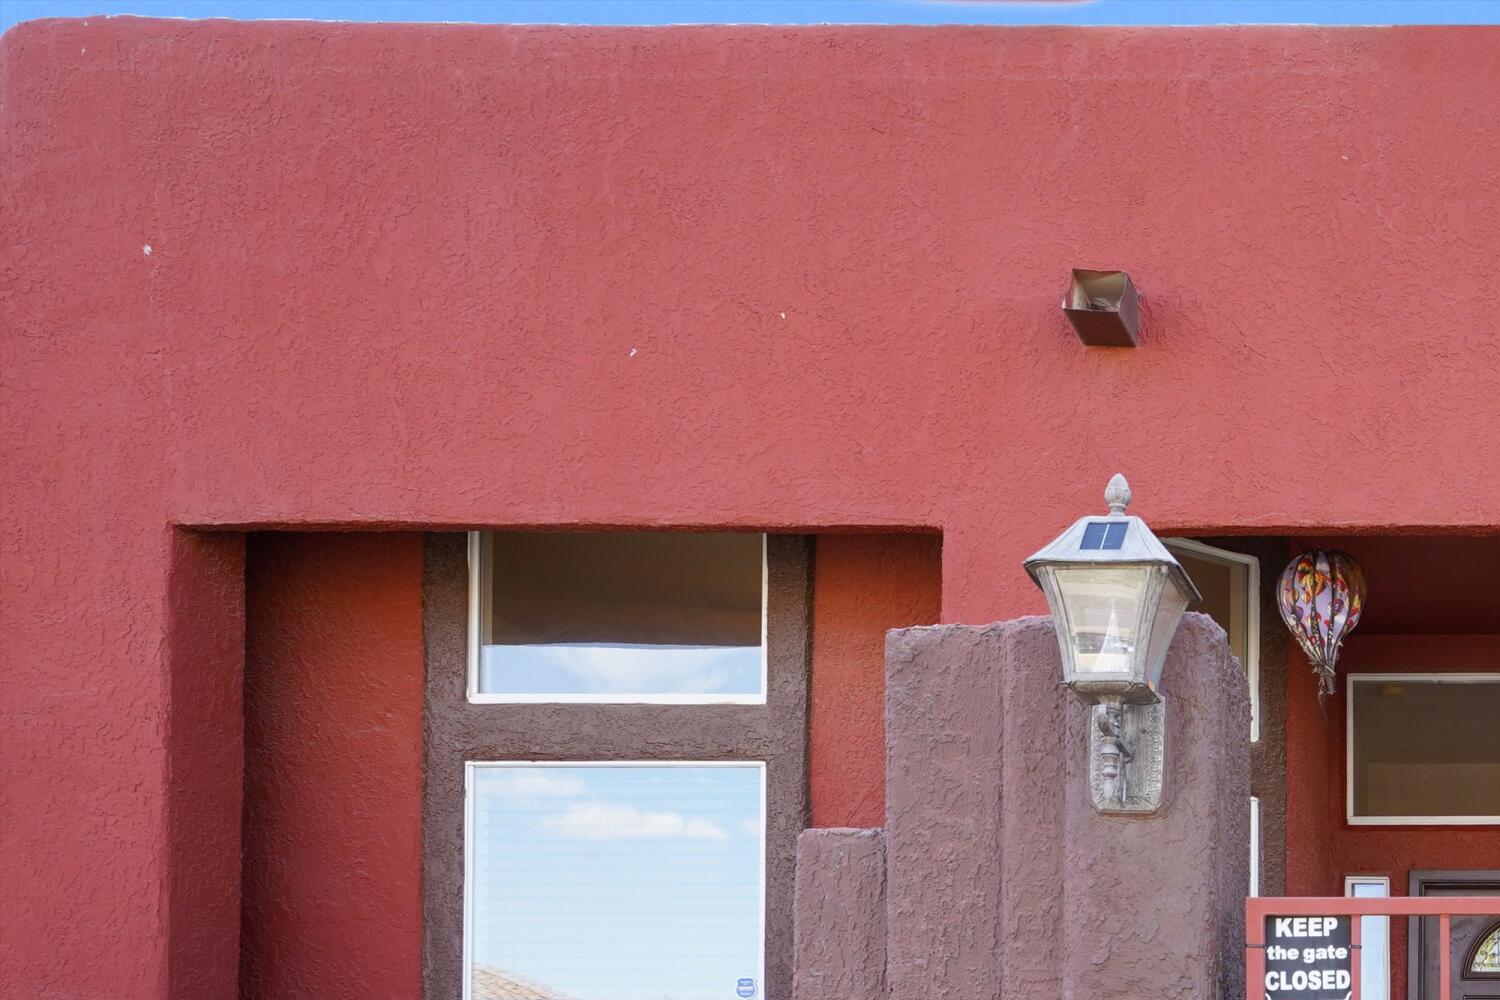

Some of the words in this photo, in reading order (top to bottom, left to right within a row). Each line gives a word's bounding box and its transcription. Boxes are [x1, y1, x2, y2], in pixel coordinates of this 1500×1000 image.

[1275, 917, 1338, 938] KEEP
[1266, 945, 1300, 960] the
[1303, 945, 1348, 963] gate
[1265, 970, 1351, 991] CLOSED
